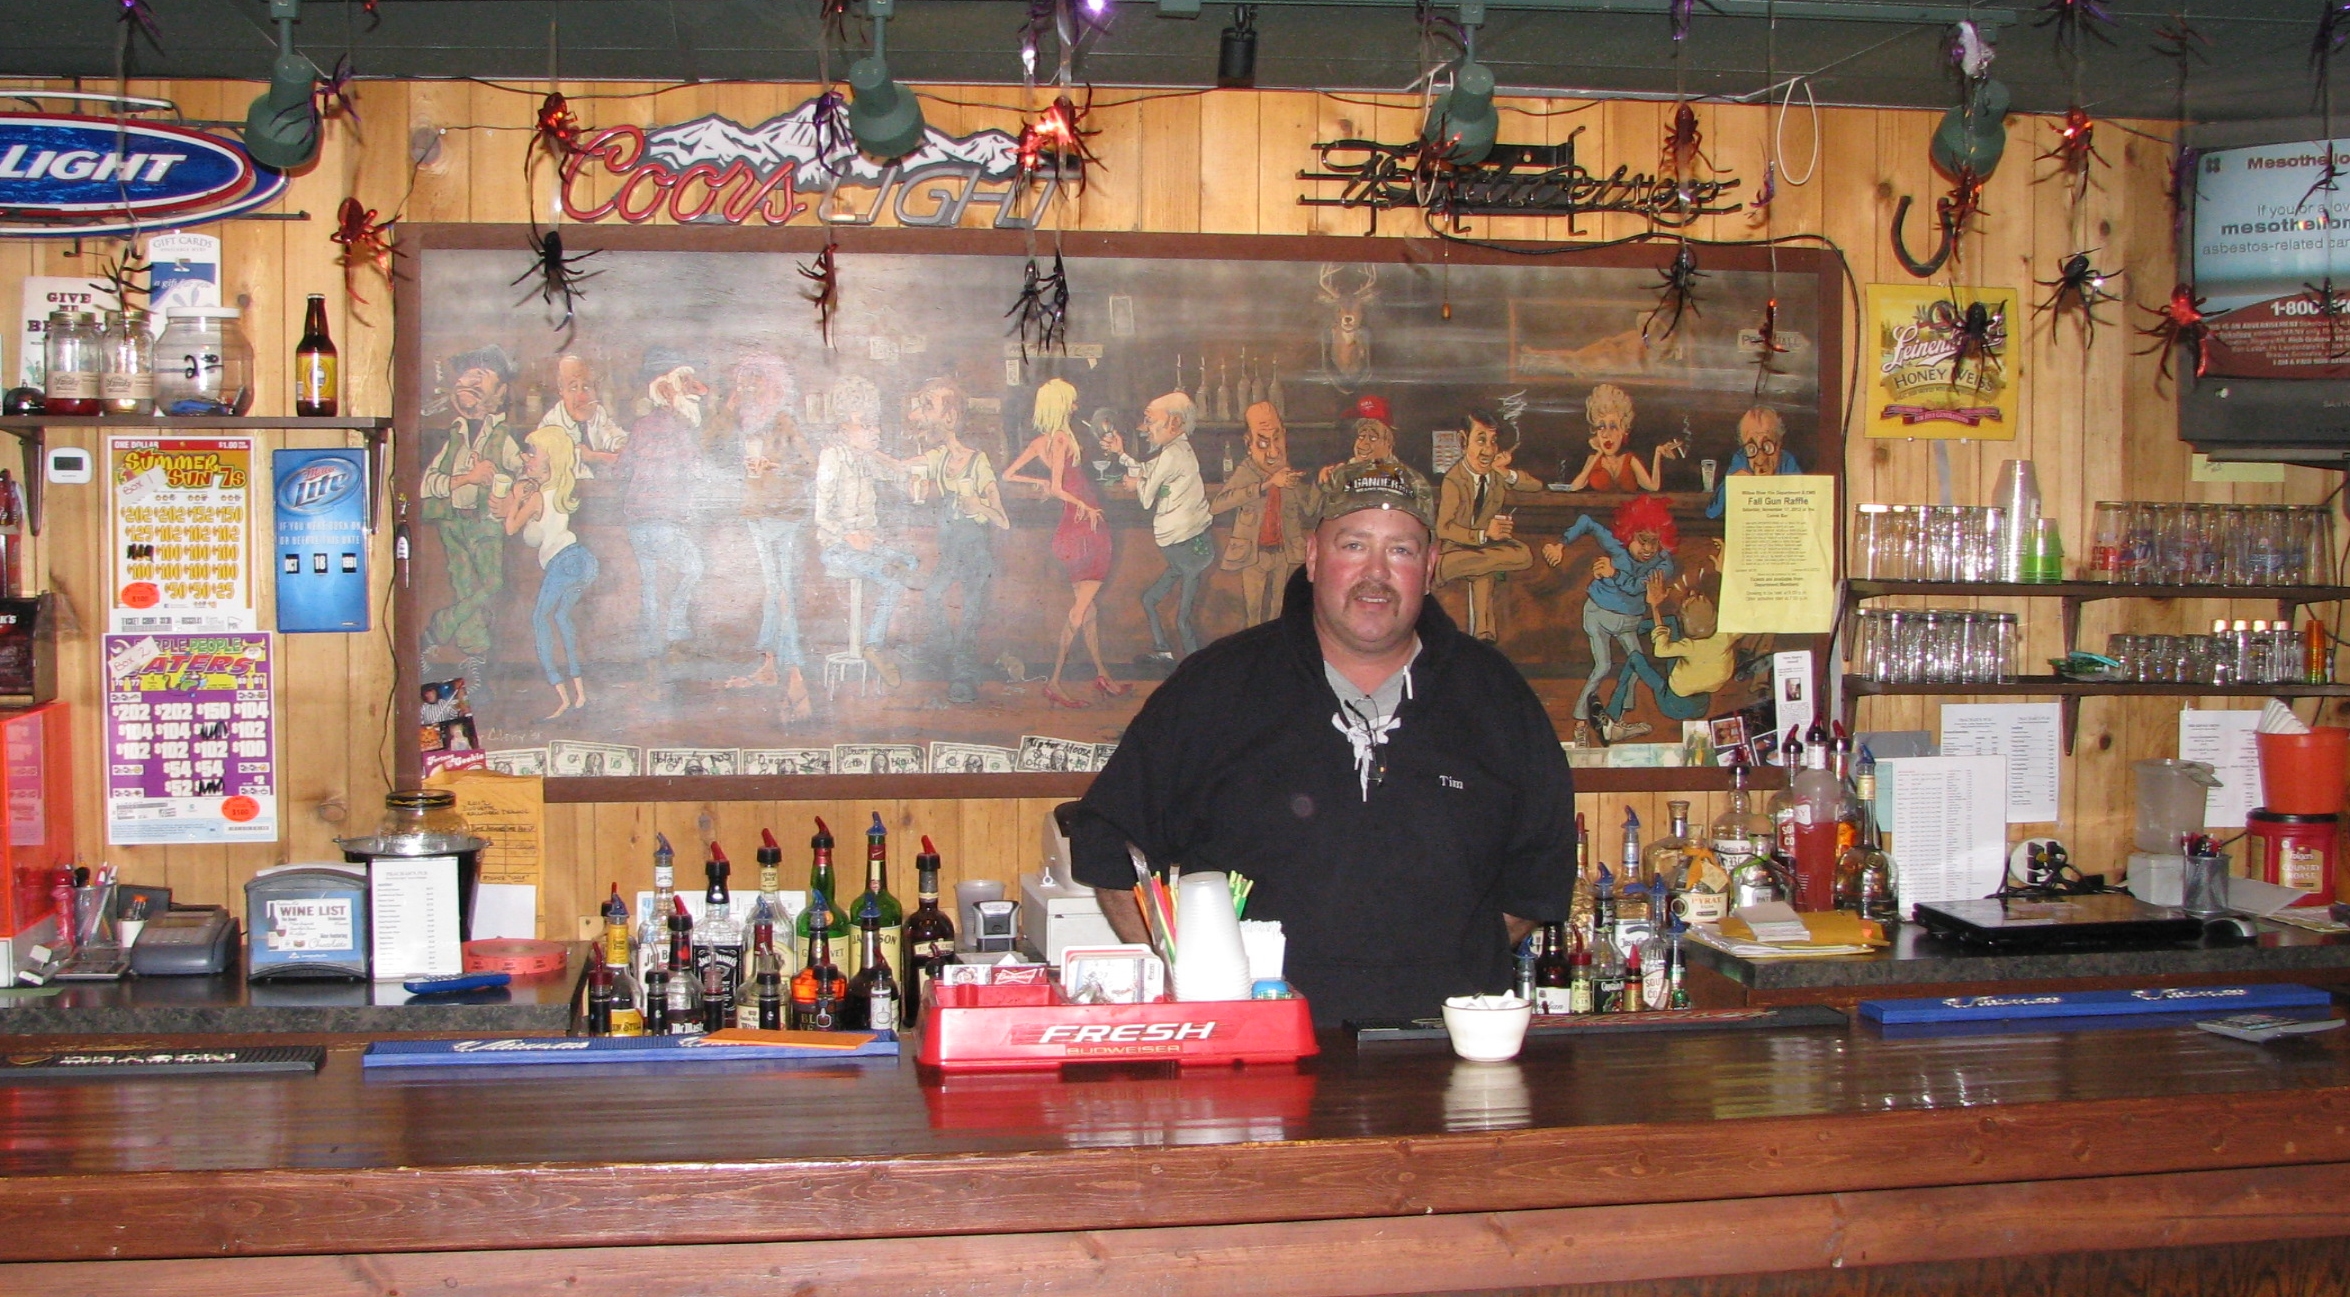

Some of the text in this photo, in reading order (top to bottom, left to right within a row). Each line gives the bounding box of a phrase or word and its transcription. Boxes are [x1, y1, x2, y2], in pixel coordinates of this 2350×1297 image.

[0, 144, 187, 183] LIGHT
[562, 124, 808, 223] Coors
[2269, 206, 2295, 219] you
[152, 235, 213, 249] GIFT CARDS
[2202, 237, 2324, 256] asbestos-related
[46, 291, 93, 304] GIVE
[1893, 368, 1948, 389] HONEY
[114, 440, 159, 449] ONE DOLLAR
[124, 450, 220, 472] SUMMER
[167, 468, 213, 488] SUN
[1353, 477, 1399, 489] GANDER
[293, 471, 350, 508] Lite
[1748, 496, 1809, 506] Fall Gun Raffle
[314, 555, 326, 570] 18
[189, 637, 242, 653] PEOPLE
[126, 654, 257, 677] ATERS
[112, 701, 270, 721] $202 $202 $150 $104
[118, 723, 154, 741] $104
[155, 722, 192, 740] $104
[231, 721, 266, 739] $102
[116, 739, 267, 760] $102 $102 $102 $100
[163, 759, 225, 778] $54 $54
[164, 779, 194, 797] $52
[1439, 775, 1465, 789] Tim
[1691, 896, 1722, 905] PYRAT
[280, 905, 346, 917] WINE LIST
[851, 933, 898, 946] JASON
[1038, 1021, 1217, 1044] FRESH
[1066, 1044, 1180, 1056] BUDWEISER
